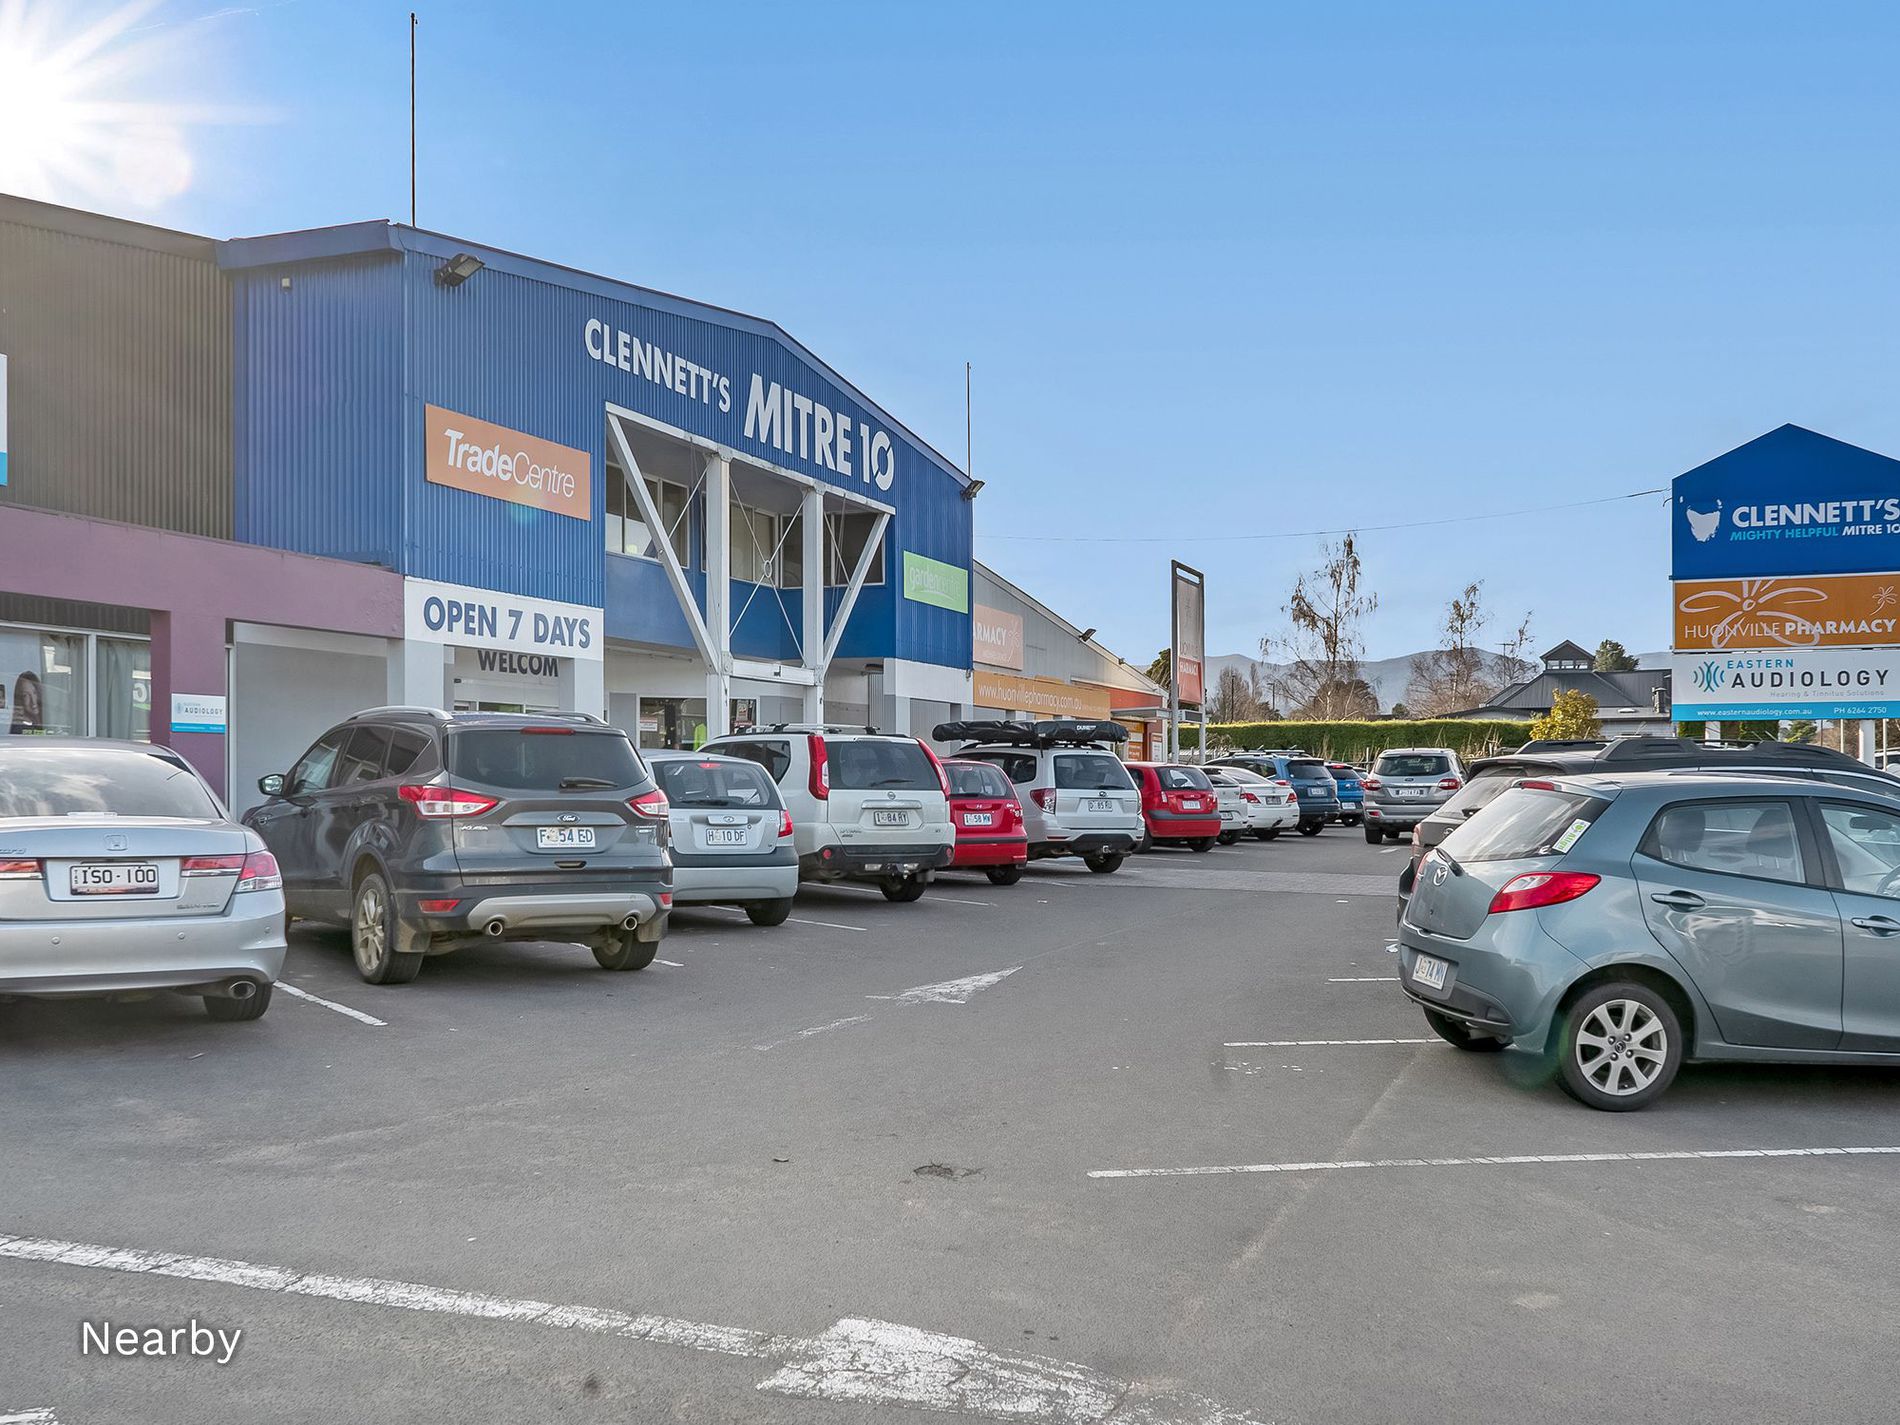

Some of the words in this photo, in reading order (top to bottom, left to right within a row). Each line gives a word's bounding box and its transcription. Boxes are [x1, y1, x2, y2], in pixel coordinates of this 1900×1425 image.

[584, 318, 731, 413] CLENNETT'S
[744, 373, 852, 477] MITRE
[860, 422, 895, 491] 10
[444, 428, 575, 498] TradeCentre
[1732, 498, 1900, 528] CLENNETT'S
[1730, 528, 1782, 542] MIGHTY
[1785, 526, 1839, 539] HELPFUL
[1842, 524, 1883, 537] MITRE
[1885, 522, 1900, 535] 10
[424, 596, 497, 638] OPEN
[508, 609, 524, 640] 7
[534, 613, 591, 649] DAYS
[1684, 622, 1780, 639] HUONVILLE
[1784, 618, 1897, 636] PHARMACY
[477, 650, 559, 677] WELCOM
[1727, 659, 1795, 669] EASTERN
[1731, 670, 1889, 689] AUDIOLOGY
[1770, 691, 1801, 699] Hearing
[1847, 689, 1885, 697] Solutions
[184, 707, 224, 715] AUDIOLOGY
[1697, 708, 1813, 718] www.easternaudiology.com.au
[1847, 706, 1867, 714] 6264
[1868, 706, 1888, 714] 2750
[540, 829, 547, 843] F
[559, 828, 574, 843] 54
[578, 828, 594, 843] ED
[708, 830, 714, 842] H
[722, 830, 732, 842] 10
[734, 830, 745, 842] DF
